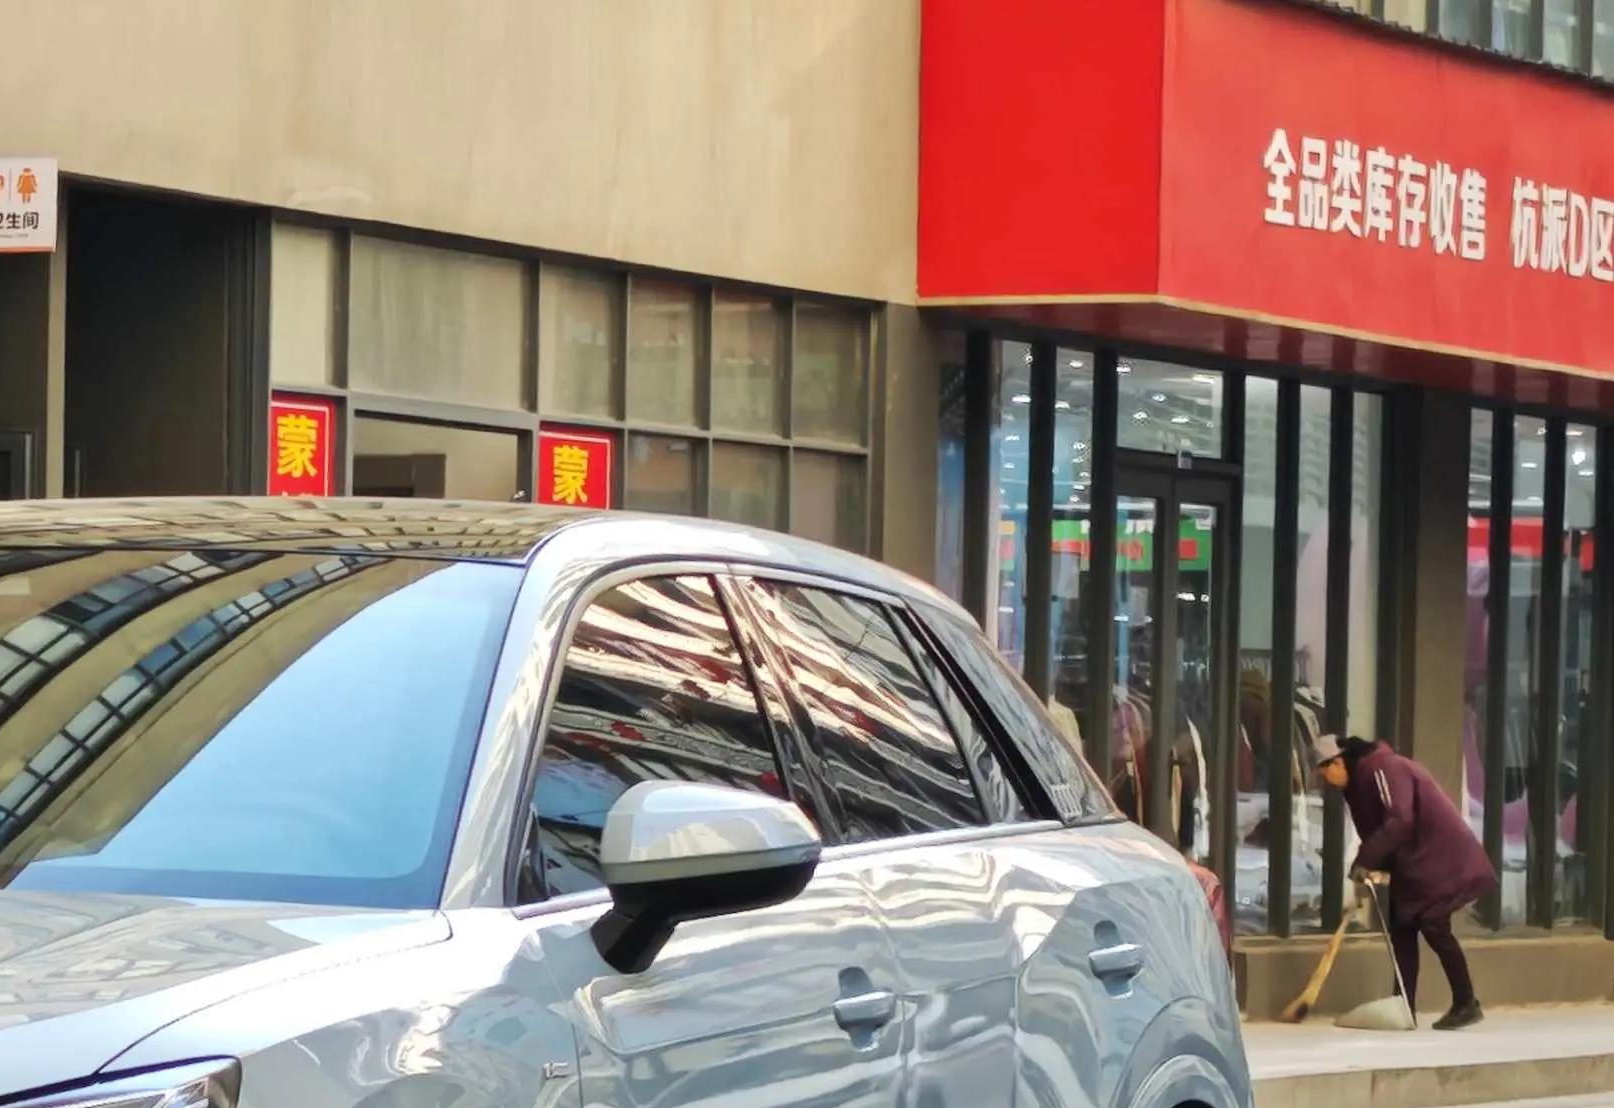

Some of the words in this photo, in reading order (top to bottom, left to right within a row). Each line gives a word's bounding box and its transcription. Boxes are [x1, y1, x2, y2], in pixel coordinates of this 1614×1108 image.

[1263, 128, 1485, 260] 全品类库存收售
[1511, 176, 1614, 282] 杭派D区
[276, 414, 318, 478] 蒙
[552, 446, 588, 504] 蒙
